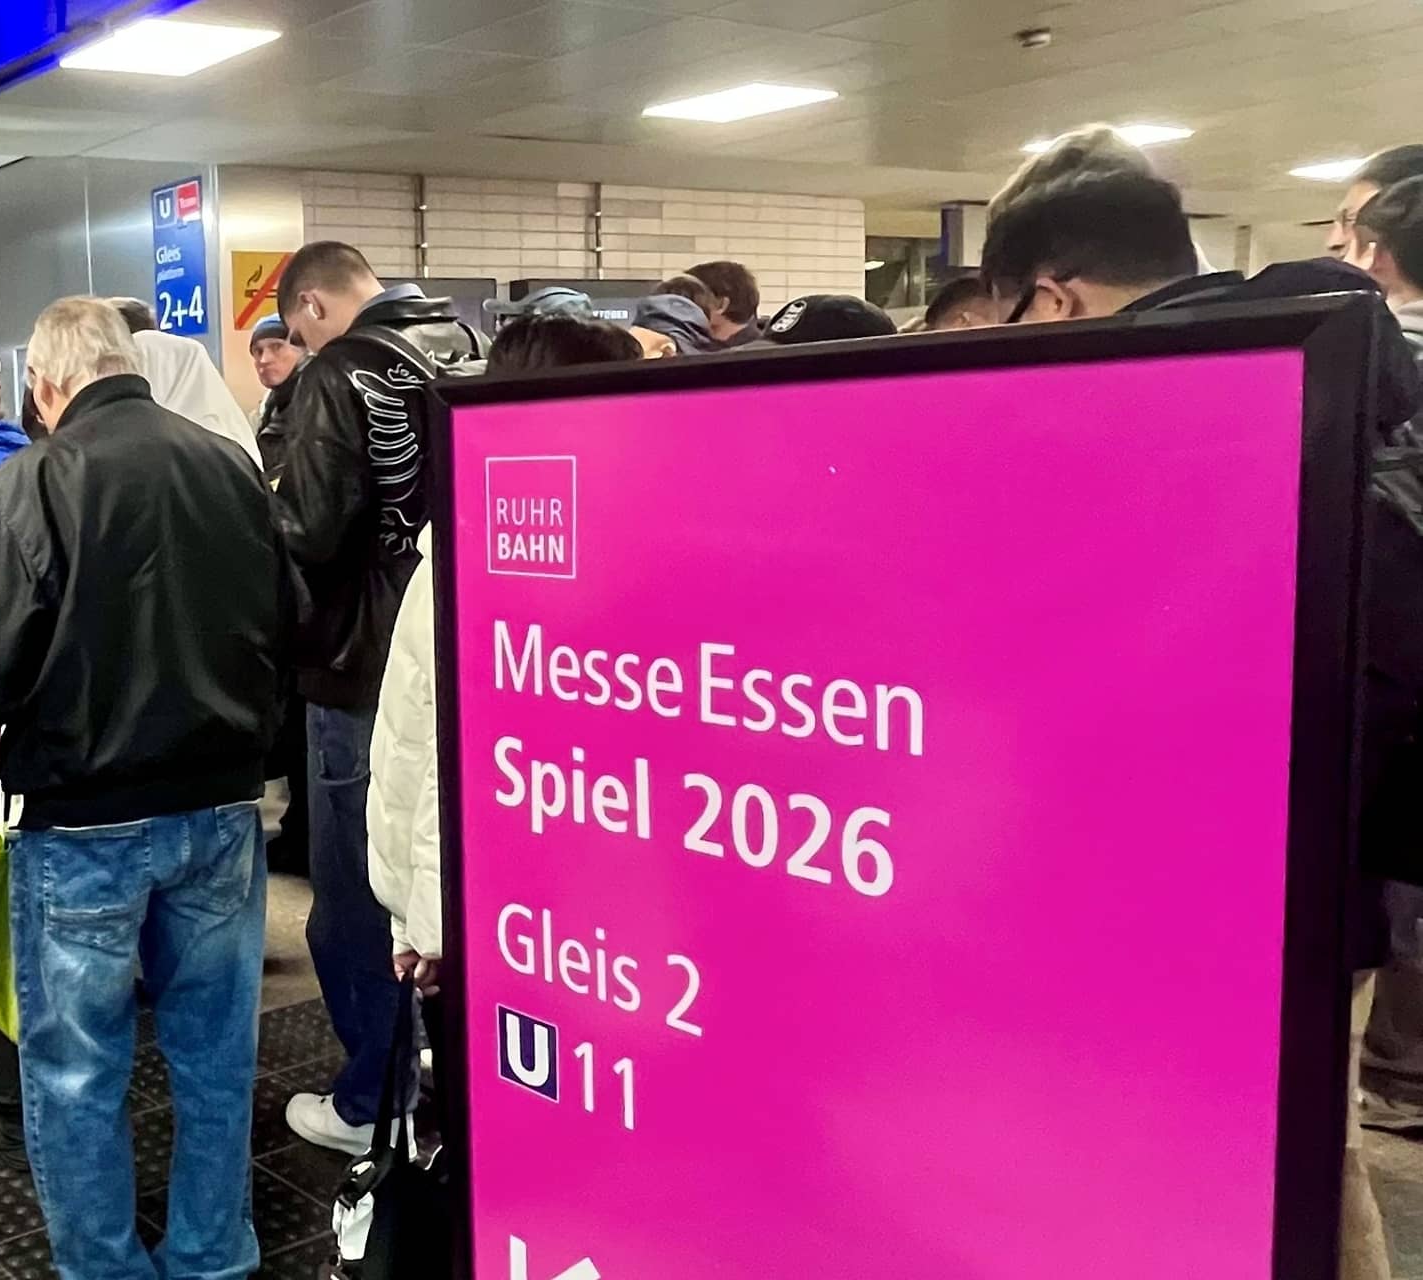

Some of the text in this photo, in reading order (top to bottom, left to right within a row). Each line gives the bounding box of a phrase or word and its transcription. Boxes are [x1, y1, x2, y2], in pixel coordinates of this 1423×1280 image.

[159, 198, 171, 218] U
[156, 245, 181, 264] Gleis
[159, 285, 204, 330] 2+4
[496, 497, 563, 527] RUHR
[497, 533, 564, 563] BAHN
[493, 619, 924, 756] Messe Essen
[493, 736, 894, 897] Spiel 2026
[497, 903, 703, 1037] Gleis 2
[505, 1013, 635, 1130] U 11
